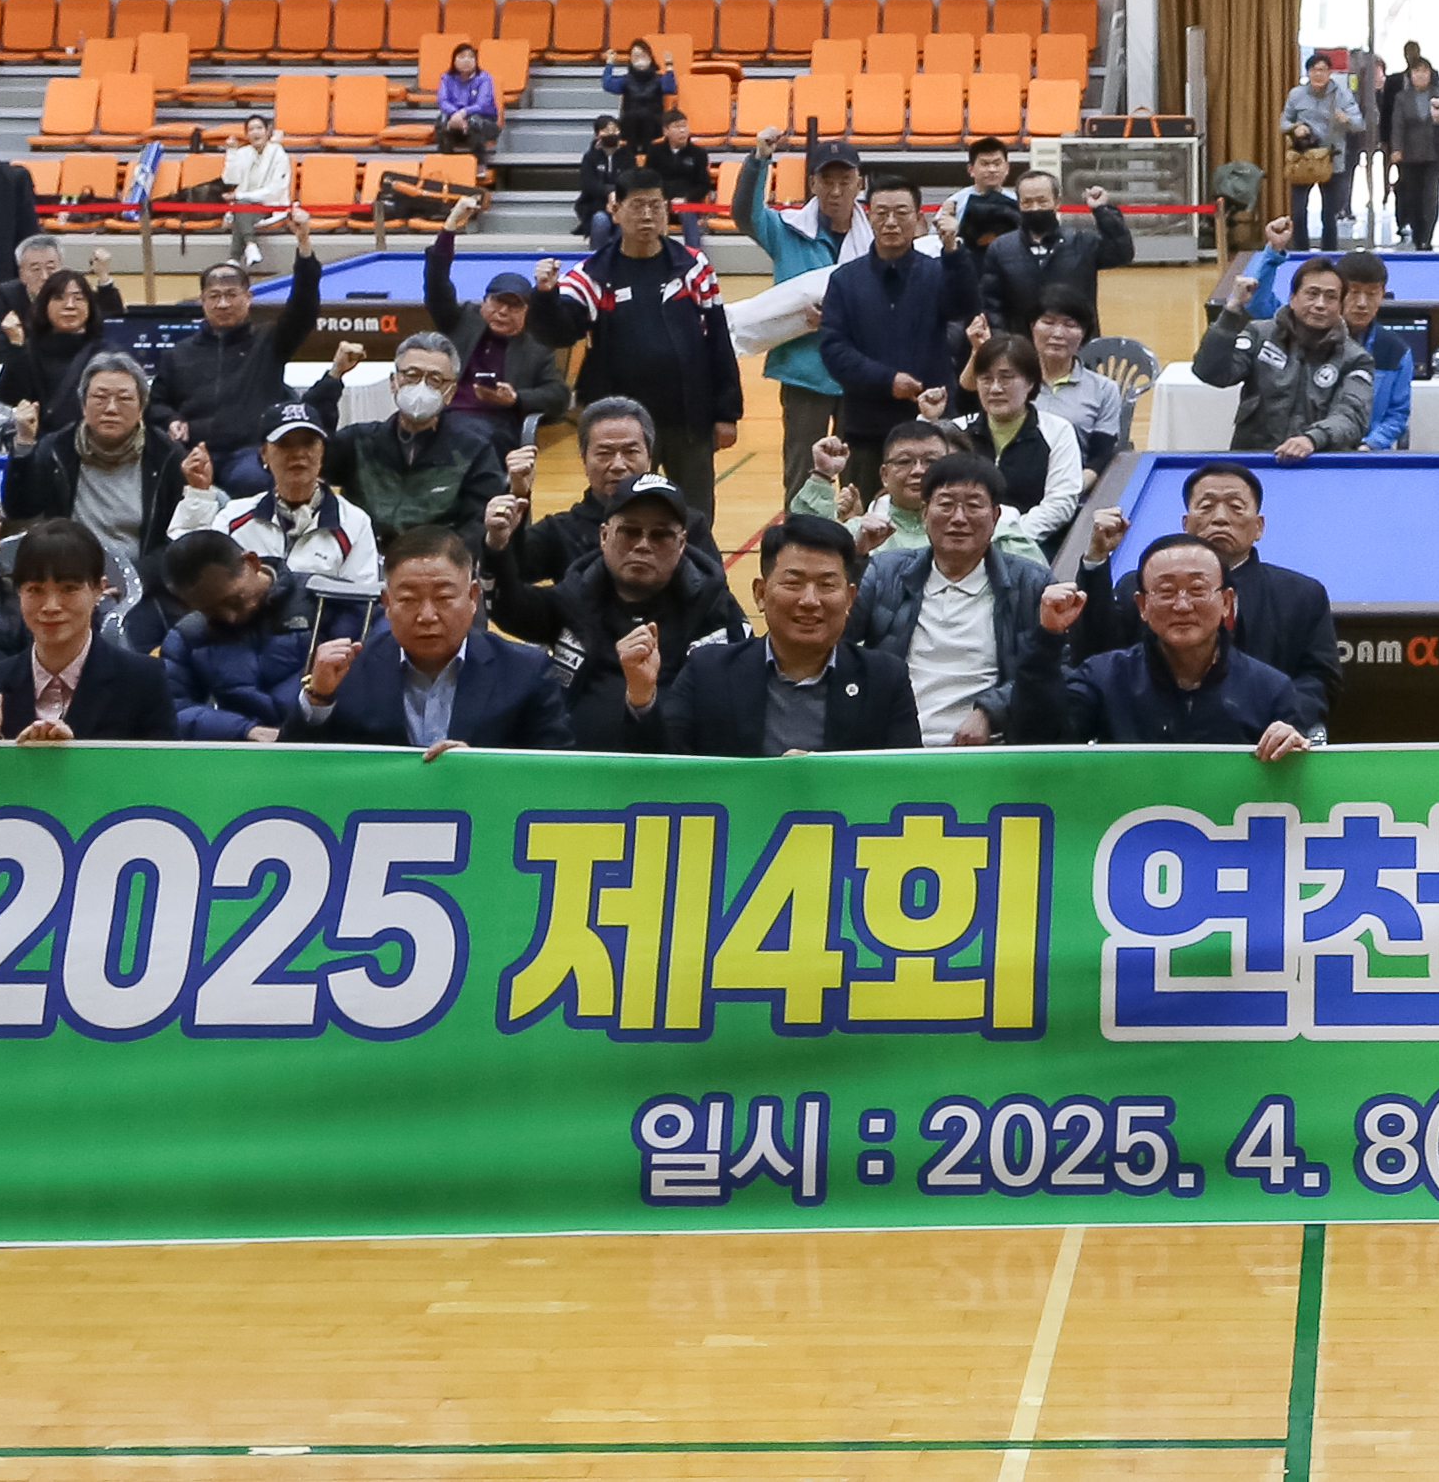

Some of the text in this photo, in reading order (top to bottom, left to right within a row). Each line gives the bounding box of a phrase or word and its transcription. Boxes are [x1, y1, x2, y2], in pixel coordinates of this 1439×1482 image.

[504, 809, 1048, 1035] 제4회
[637, 1098, 822, 1200] 일시
[925, 1101, 1200, 1188] 2025.
[1232, 1100, 1325, 1191] 4.
